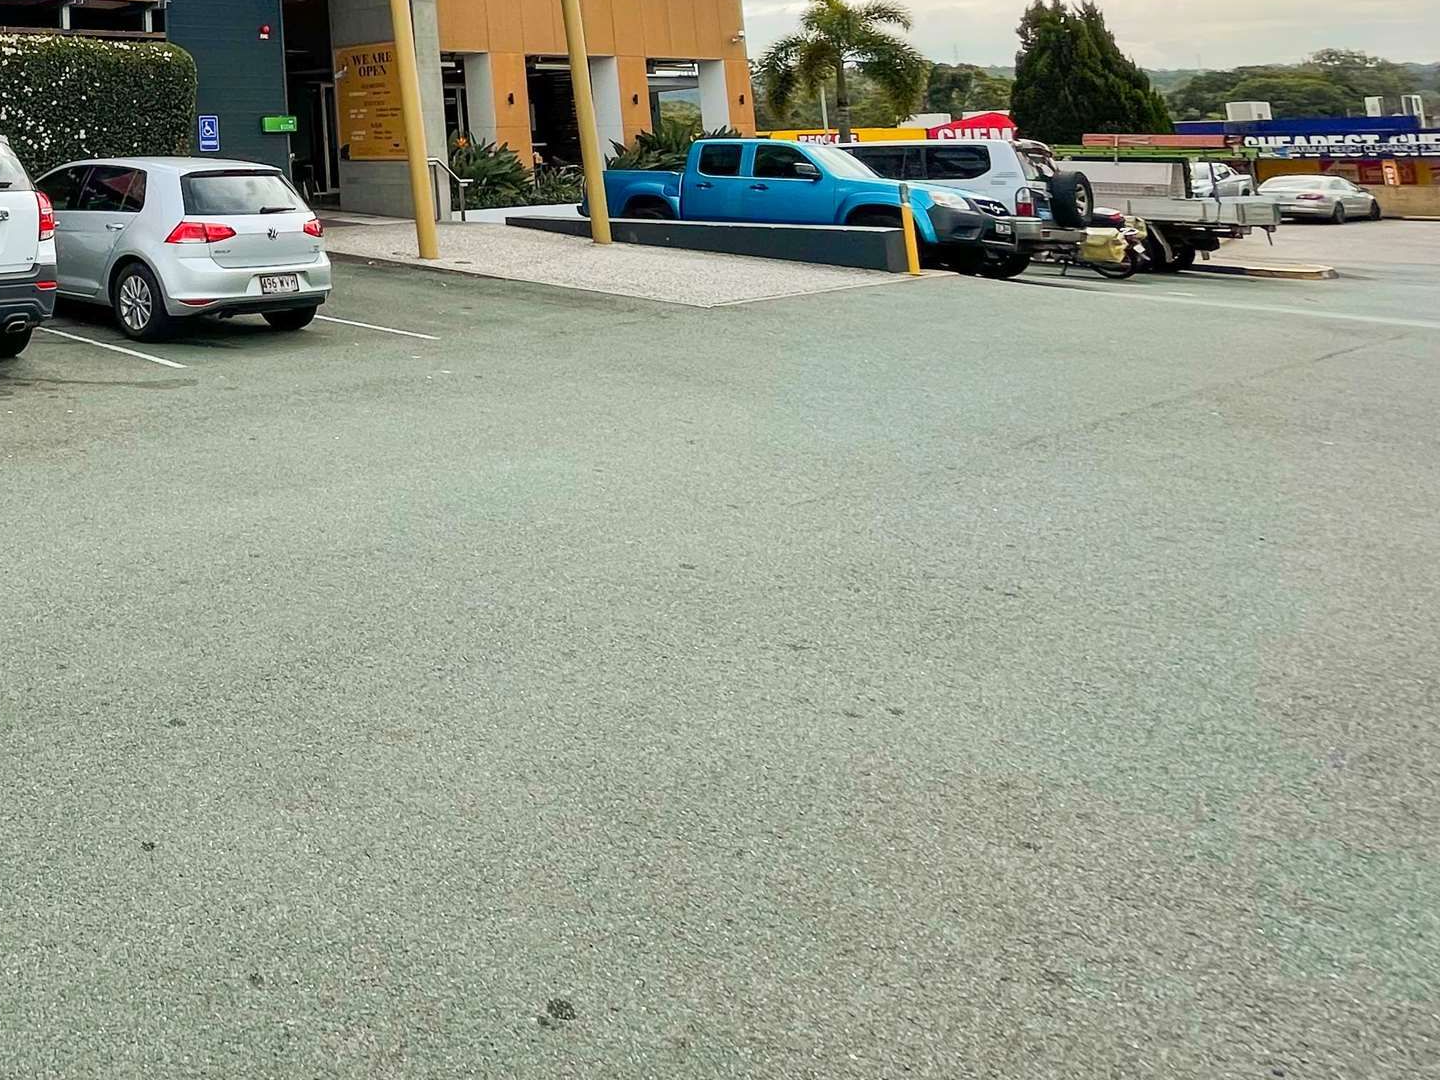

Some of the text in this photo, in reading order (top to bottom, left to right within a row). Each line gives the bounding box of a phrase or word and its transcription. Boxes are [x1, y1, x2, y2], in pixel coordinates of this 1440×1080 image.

[352, 51, 393, 66] WE ARE
[358, 65, 387, 77] OPEN
